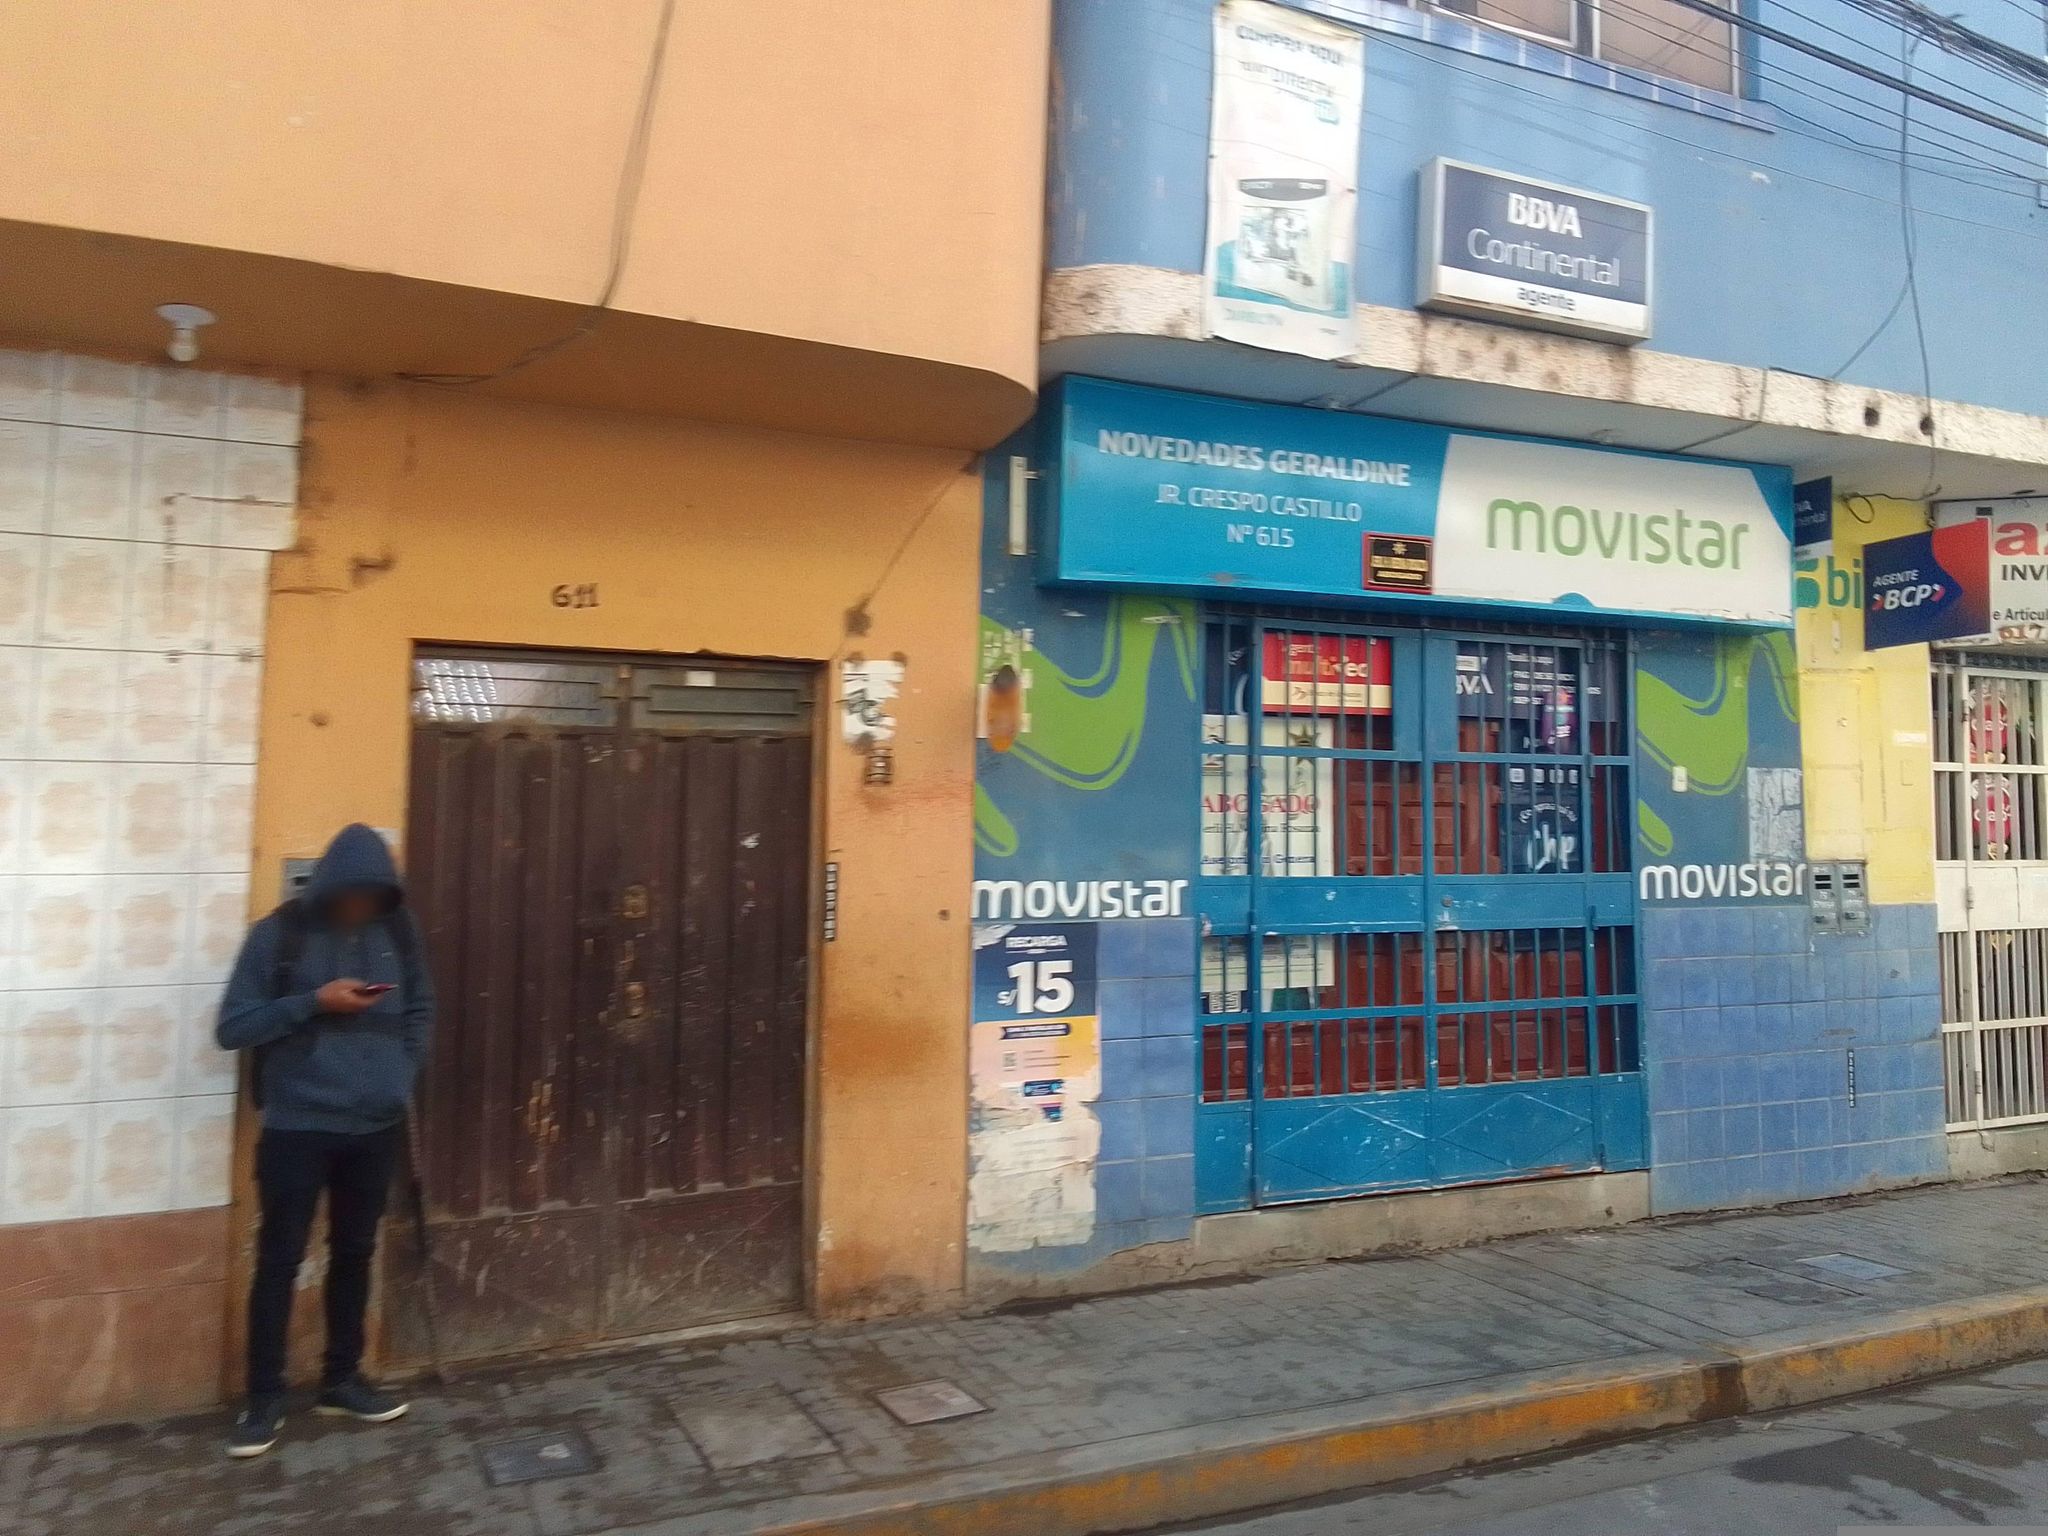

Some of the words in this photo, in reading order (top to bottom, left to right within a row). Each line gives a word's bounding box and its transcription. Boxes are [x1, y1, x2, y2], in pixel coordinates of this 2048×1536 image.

[1507, 192, 1583, 239] BBVA
[1467, 228, 1621, 288] Continental
[1517, 287, 1577, 312] agente
[1097, 429, 1265, 472] NOVEDADES
[1269, 449, 1412, 488] GERALDINE
[1187, 486, 1269, 515] CRESPO
[1270, 495, 1363, 523] CASTILLO
[1255, 525, 1296, 549] 615
[1486, 498, 1750, 571] movistar
[1872, 569, 1920, 588] AGENTE
[2001, 563, 2048, 581] INV
[1883, 584, 1933, 611] BCP
[971, 879, 1189, 919] movistar
[1639, 863, 1808, 900] movistar
[1007, 960, 1075, 1014] 15
